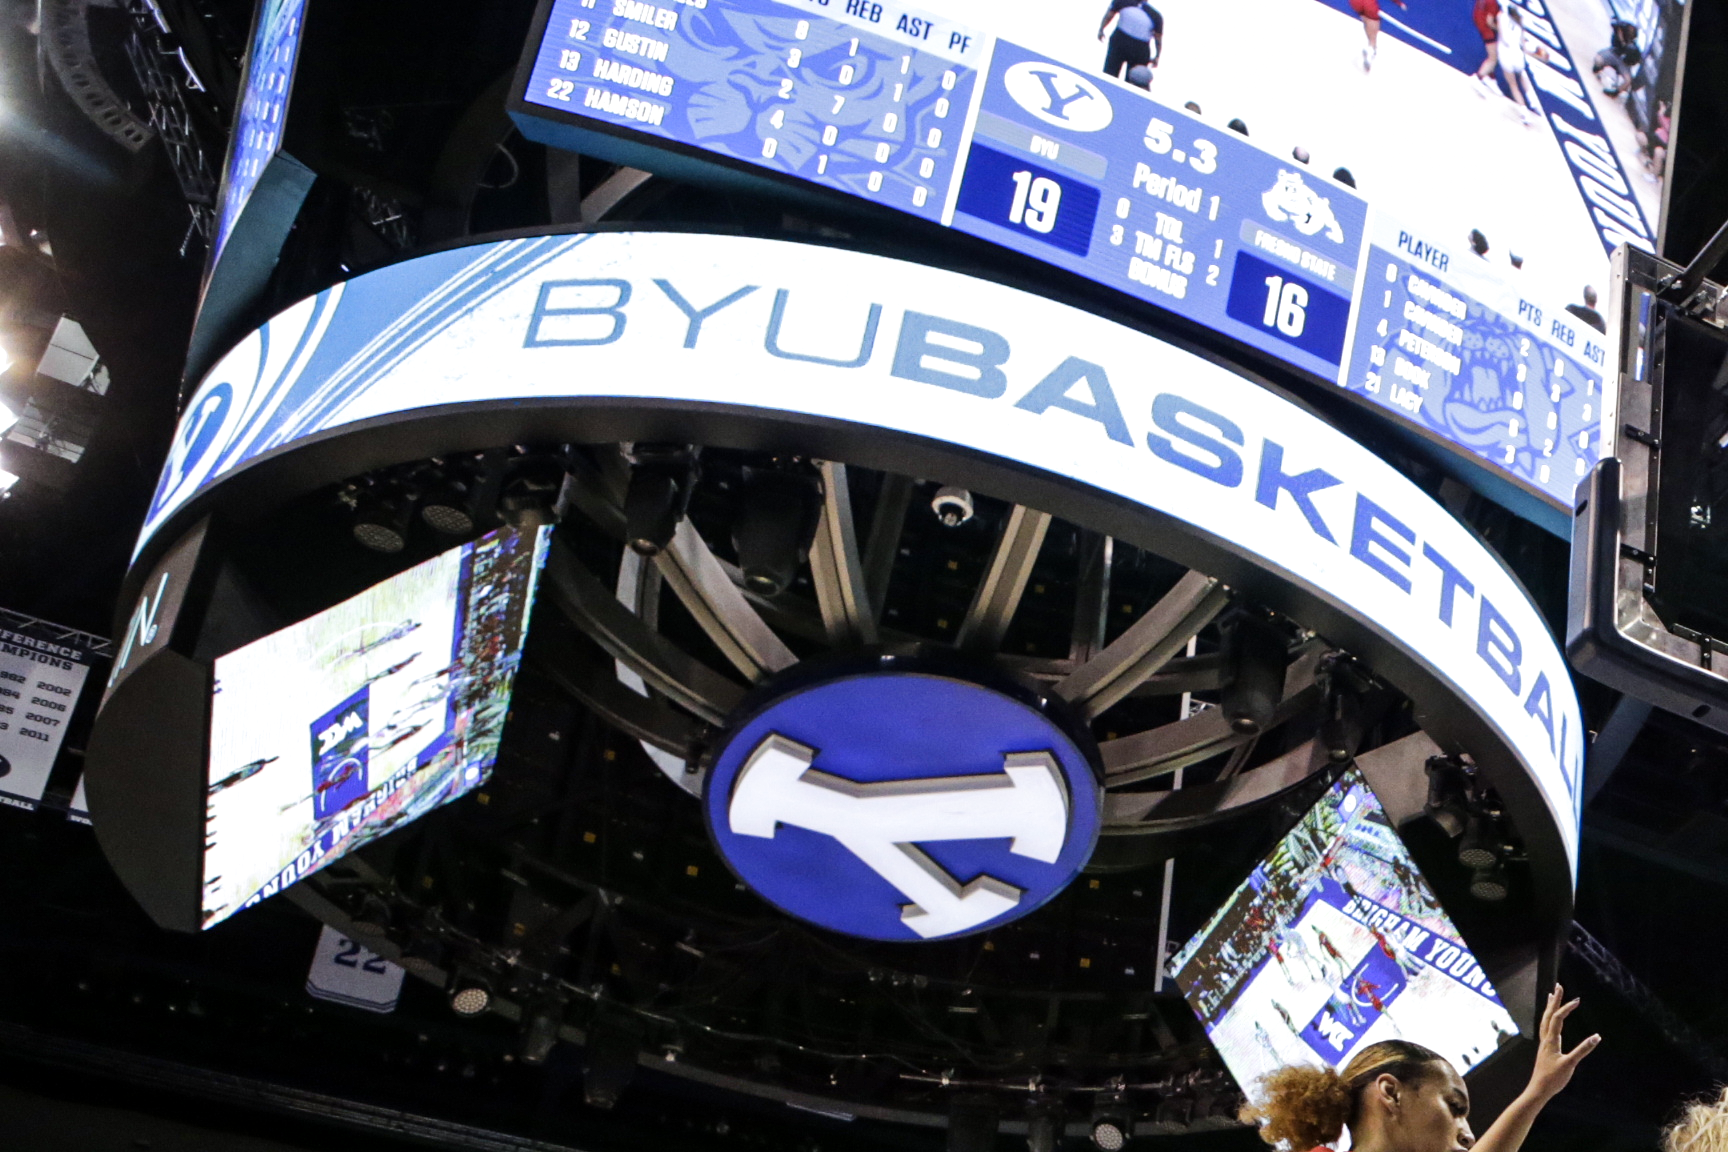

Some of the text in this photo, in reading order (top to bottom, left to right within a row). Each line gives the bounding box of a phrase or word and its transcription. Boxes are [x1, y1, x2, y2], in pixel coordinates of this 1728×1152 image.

[613, 0, 679, 31] SMILER
[838, 64, 855, 86] 0
[893, 83, 903, 103] 1
[934, 97, 950, 119] 0
[896, 13, 935, 41] AST
[948, 31, 972, 54] PF
[569, 19, 943, 149] 12 GUSTIN 2 7 0 0
[849, 37, 860, 57] 1
[901, 55, 911, 75] 1
[941, 70, 957, 91] 0
[559, 50, 935, 179] 13 HARDING 4 0 0 0
[547, 79, 928, 208] 22 HAMSON 0 1 0 0
[1030, 135, 1059, 160] BYU
[1144, 117, 1218, 174] 5.3
[1009, 171, 1062, 233] 19
[1133, 162, 1220, 221] Period 1
[1110, 225, 1124, 245] 3
[1136, 231, 1163, 261] TM
[1206, 265, 1219, 286] 2
[1214, 239, 1223, 259] 1
[1255, 230, 1336, 281] FRESNO STATE
[1263, 276, 1308, 337] 16
[1384, 290, 1392, 308] 1
[1398, 230, 1449, 272] PLAYER
[1519, 299, 1543, 327] PTS
[1551, 320, 1575, 347] REB
[0, 628, 82, 660] FERENCE
[37, 681, 72, 698] 2002
[25, 712, 61, 727] 2007
